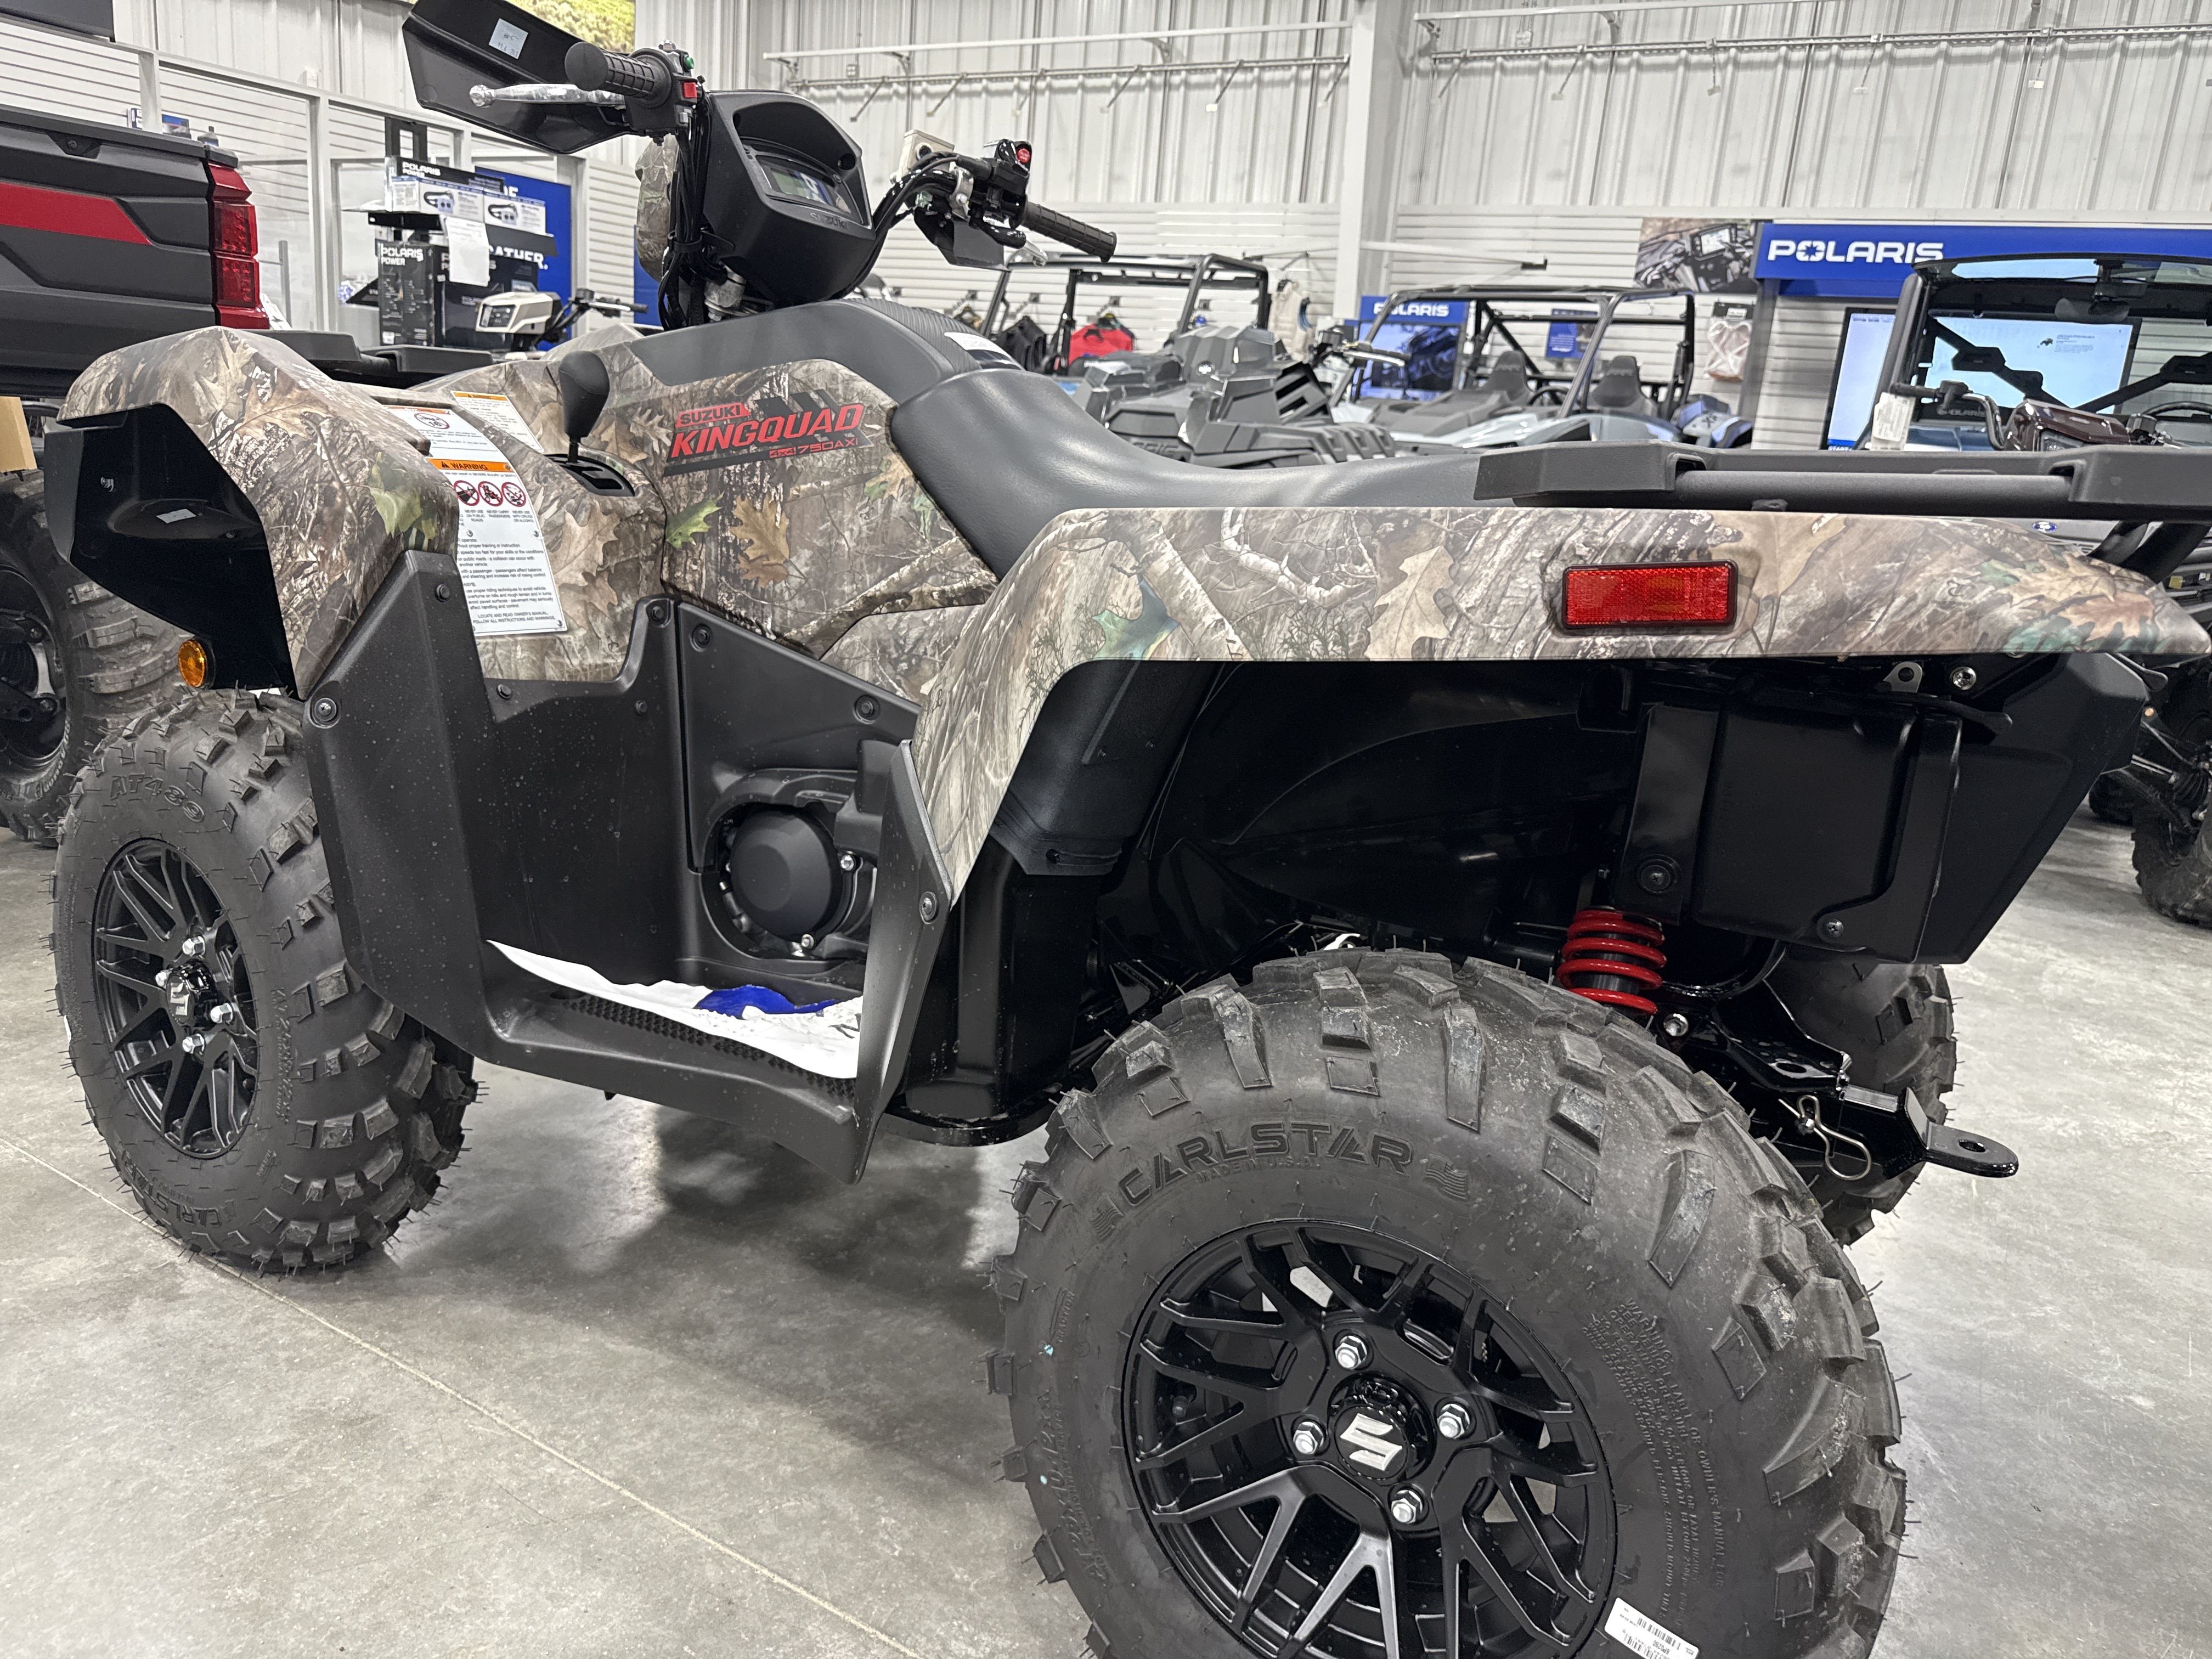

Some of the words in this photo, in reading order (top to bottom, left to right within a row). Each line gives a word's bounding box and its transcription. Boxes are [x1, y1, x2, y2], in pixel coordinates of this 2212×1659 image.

[403, 162, 441, 176] POLARIS
[381, 247, 424, 259] POLARIS
[381, 257, 405, 266] POWER
[1768, 239, 1944, 264] POLARIS
[680, 405, 740, 425] SUZUKI
[670, 403, 864, 458] KINGQUAD
[770, 447, 795, 456] 4x4
[450, 462, 489, 470] WARNING
[111, 772, 205, 822] AT489
[1119, 1120, 1413, 1206] CARLSTAR
[1196, 1161, 1242, 1183] MADE
[1245, 1158, 1261, 1170] IN
[1057, 1290, 1075, 1343] TRACTION
[1610, 1310, 1657, 1373] OPERATING
[1655, 1378, 1689, 1437] PRESSURE
[1618, 1304, 1638, 1327] SEE
[1669, 1384, 1692, 1418] LABEL
